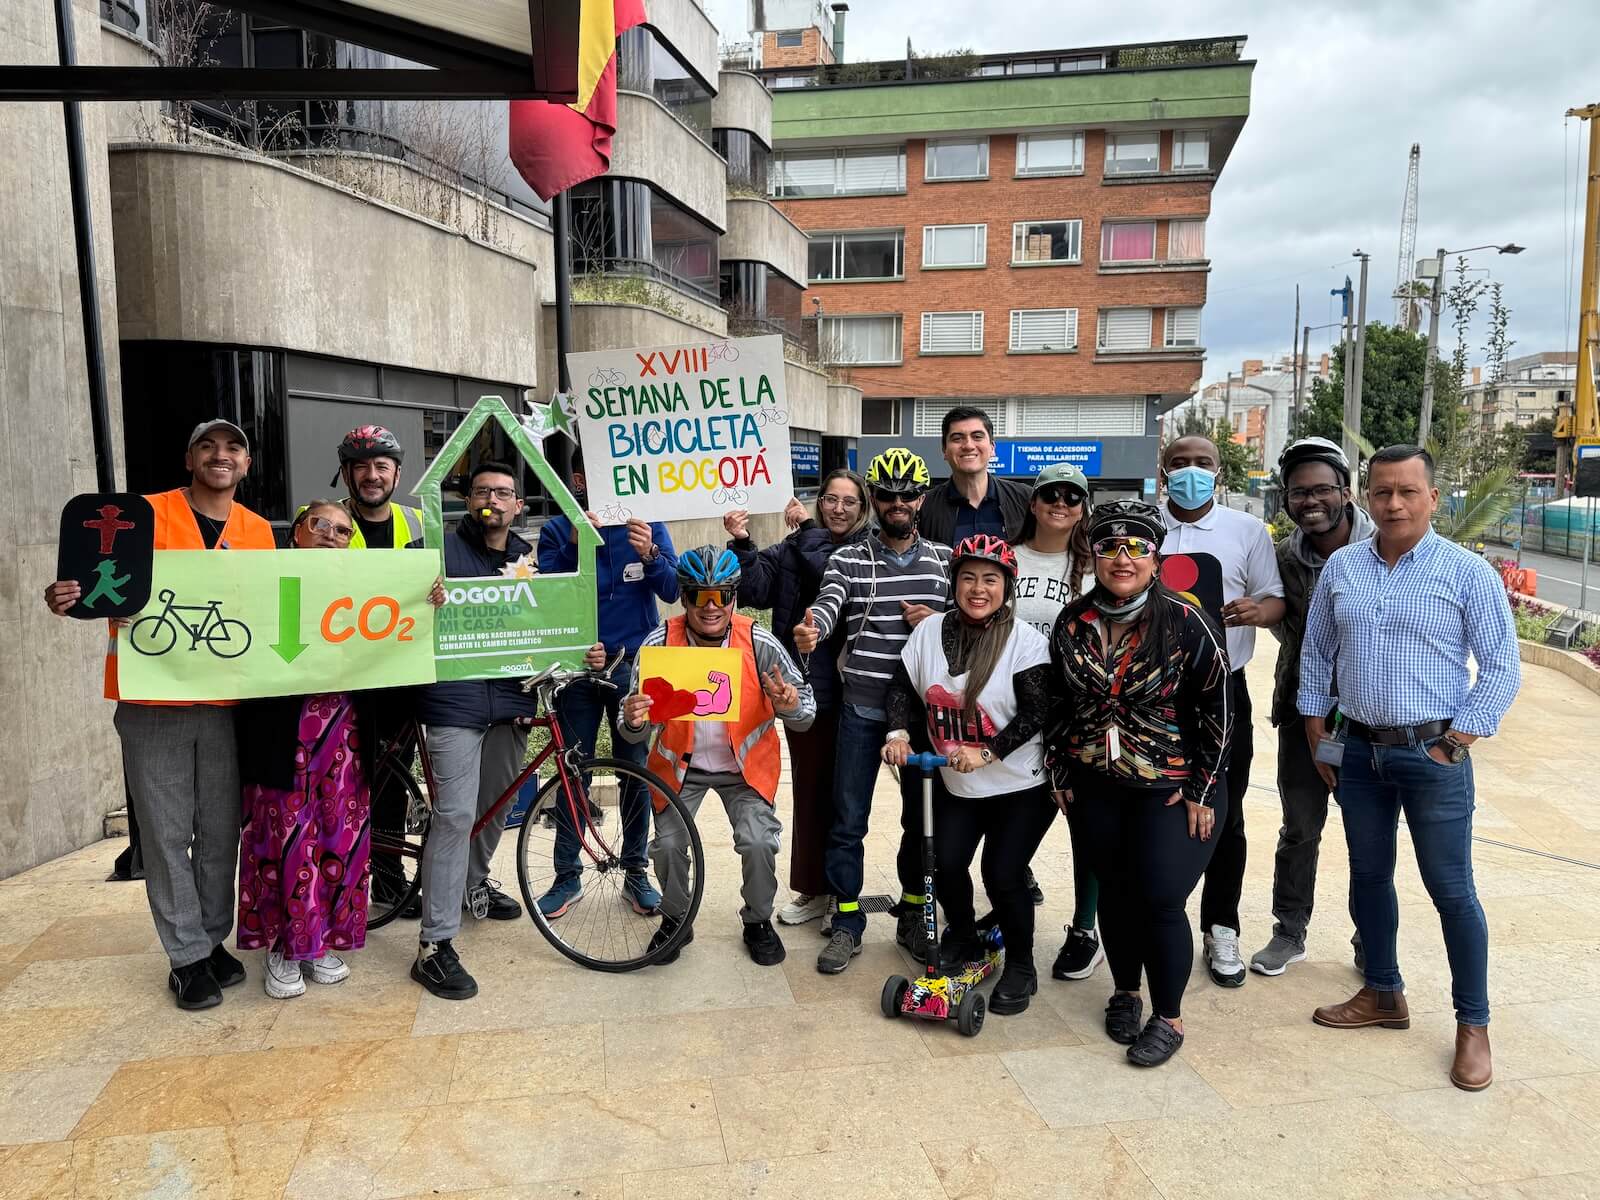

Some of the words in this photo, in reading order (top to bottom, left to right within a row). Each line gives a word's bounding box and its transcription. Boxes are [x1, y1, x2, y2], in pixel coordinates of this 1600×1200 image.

[635, 347, 709, 378] XVIII
[585, 381, 690, 420] SEMANA
[699, 377, 734, 410] DE
[739, 374, 776, 407] LA
[607, 413, 764, 459] BICICLETA
[613, 463, 650, 497] EN
[657, 447, 772, 494] BOGOTÁ
[1014, 576, 1039, 599] KE
[1043, 577, 1071, 605] ER
[438, 607, 458, 619] MI
[462, 604, 522, 618] CIUDAD
[439, 620, 458, 632] MI
[462, 618, 507, 631] CASA
[439, 641, 474, 650] COMBATIR
[482, 640, 507, 648] CAMBIO
[476, 632, 490, 640] NOS
[491, 631, 520, 639] HACEMOS
[536, 628, 562, 636] FUERTES
[926, 702, 993, 743] HILL
[924, 875, 935, 940] SCOOTER
